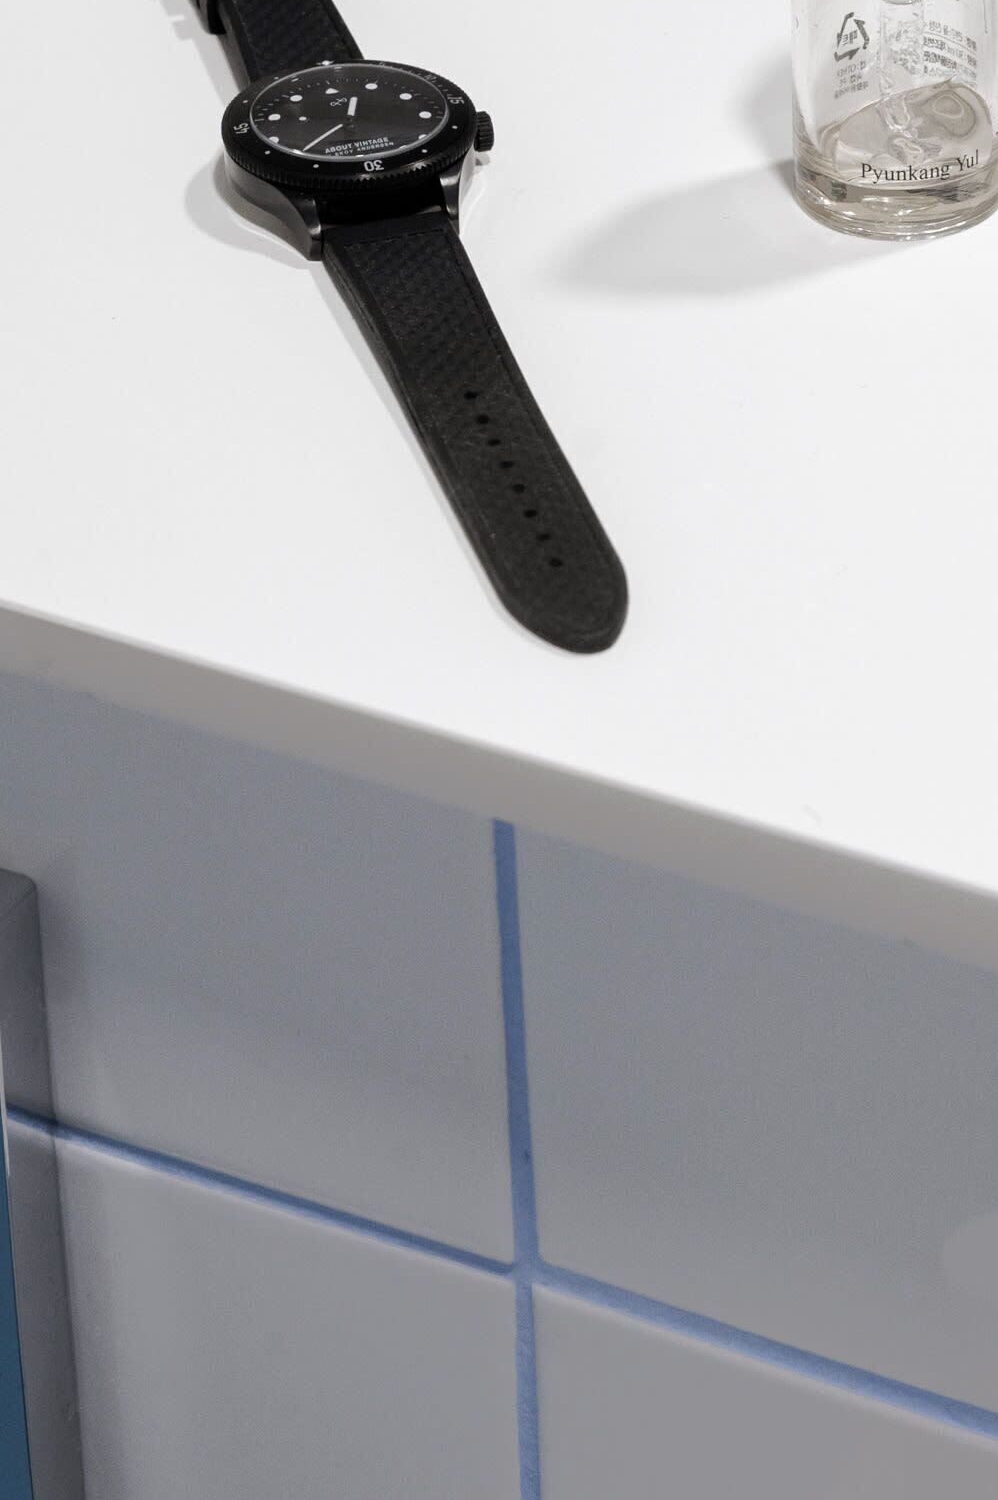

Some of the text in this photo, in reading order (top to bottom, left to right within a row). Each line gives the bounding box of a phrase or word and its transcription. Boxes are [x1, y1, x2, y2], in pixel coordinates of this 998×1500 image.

[325, 136, 389, 154] ABOUT VINTAGE
[861, 148, 979, 184] Pyunkang Yul
